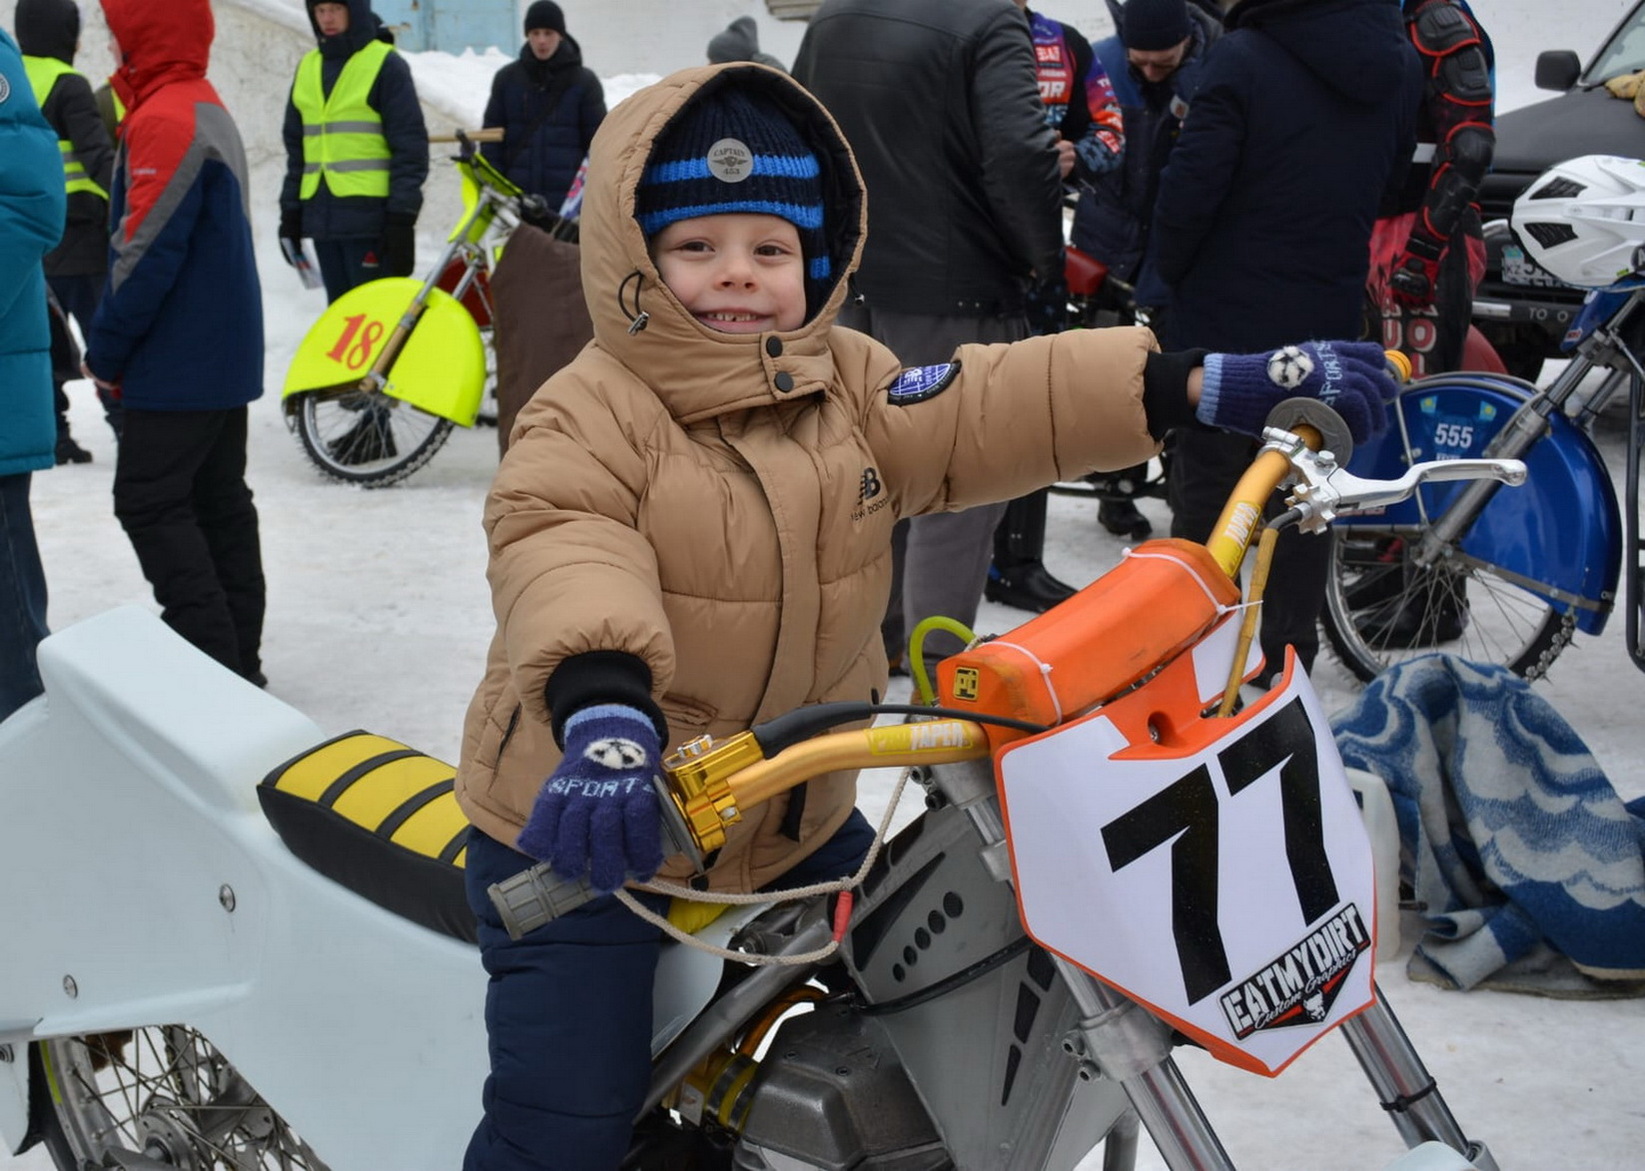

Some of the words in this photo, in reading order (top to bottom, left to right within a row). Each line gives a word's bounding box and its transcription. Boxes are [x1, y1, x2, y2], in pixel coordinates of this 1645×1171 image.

[713, 147, 746, 157] CAPTAIN
[325, 313, 384, 370] 18
[1434, 423, 1473, 449] 555
[911, 722, 964, 750] TAPER
[1100, 695, 1340, 1007] 77
[1221, 904, 1365, 1034] EATMYDIRT
[1254, 989, 1304, 1029] Custom
[1305, 948, 1357, 993] Graphics
